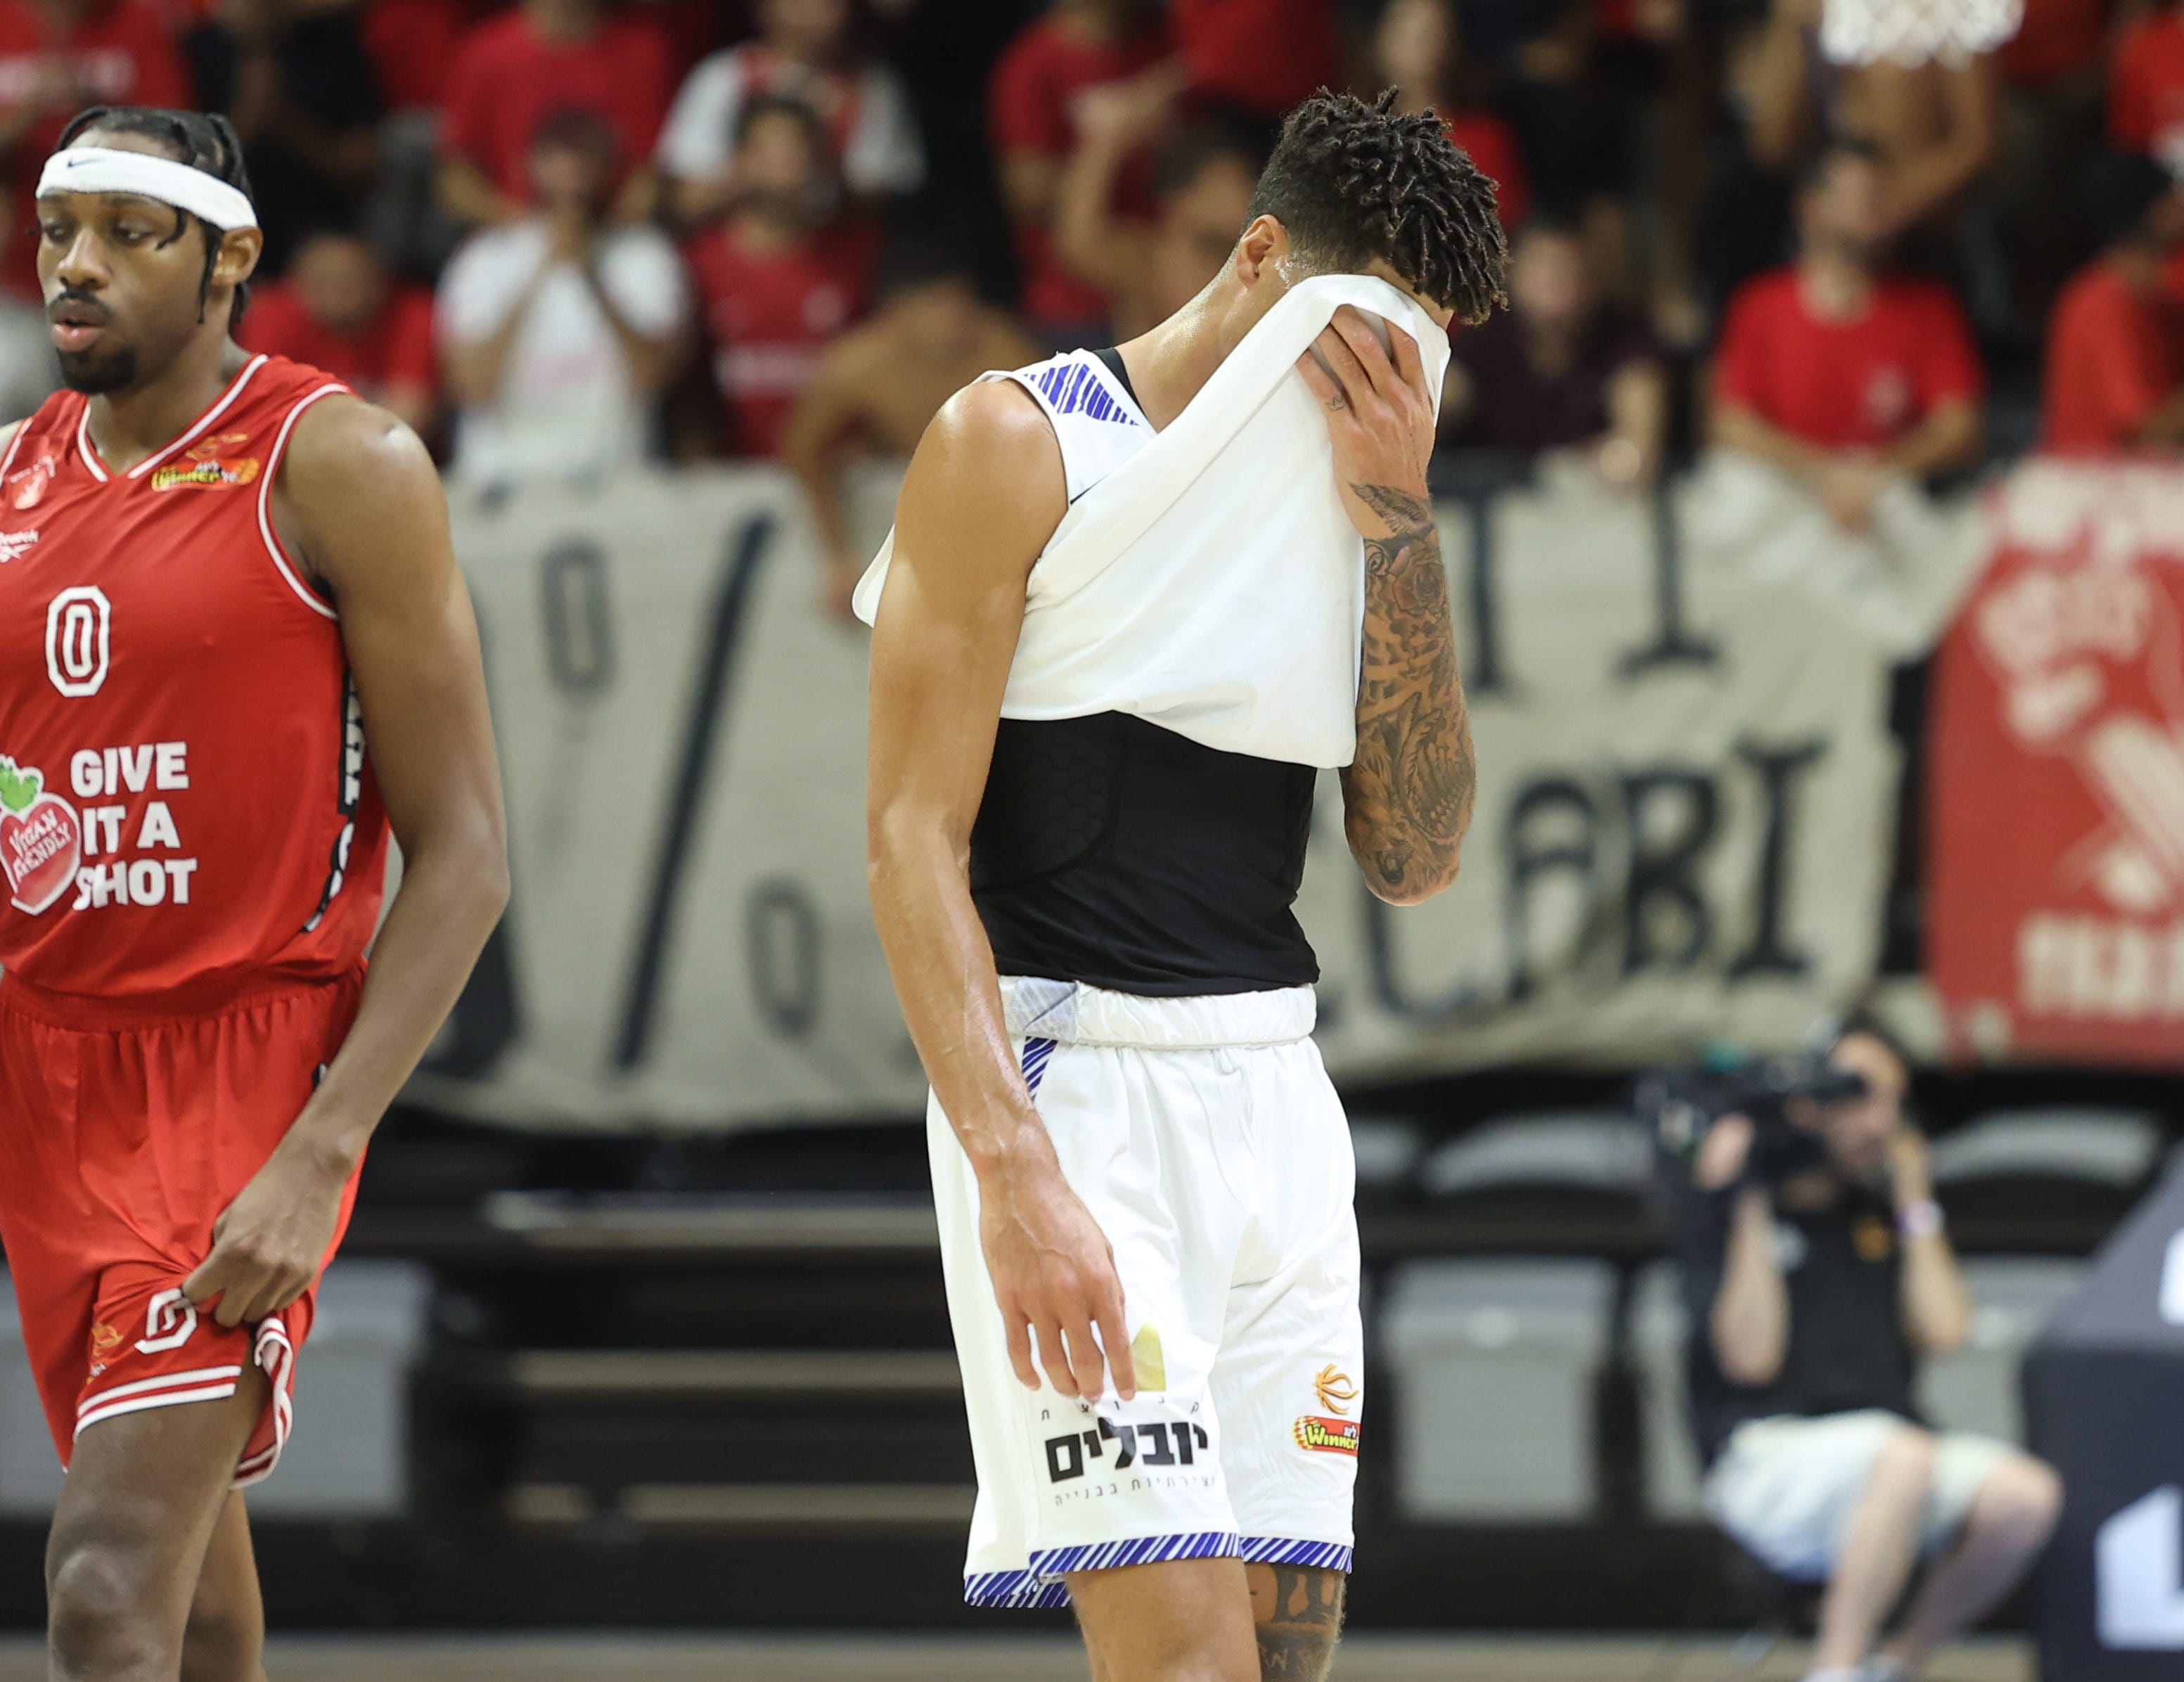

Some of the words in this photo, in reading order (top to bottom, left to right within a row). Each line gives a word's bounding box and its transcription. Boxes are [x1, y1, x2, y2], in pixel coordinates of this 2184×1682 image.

[45, 585, 112, 698] 0
[70, 741, 190, 798] GIVE
[82, 804, 127, 855] IT
[136, 800, 181, 849] A
[71, 857, 198, 911] SHOT
[1044, 1416, 1209, 1484] יובלים
[1305, 1423, 1357, 1451] Winner
